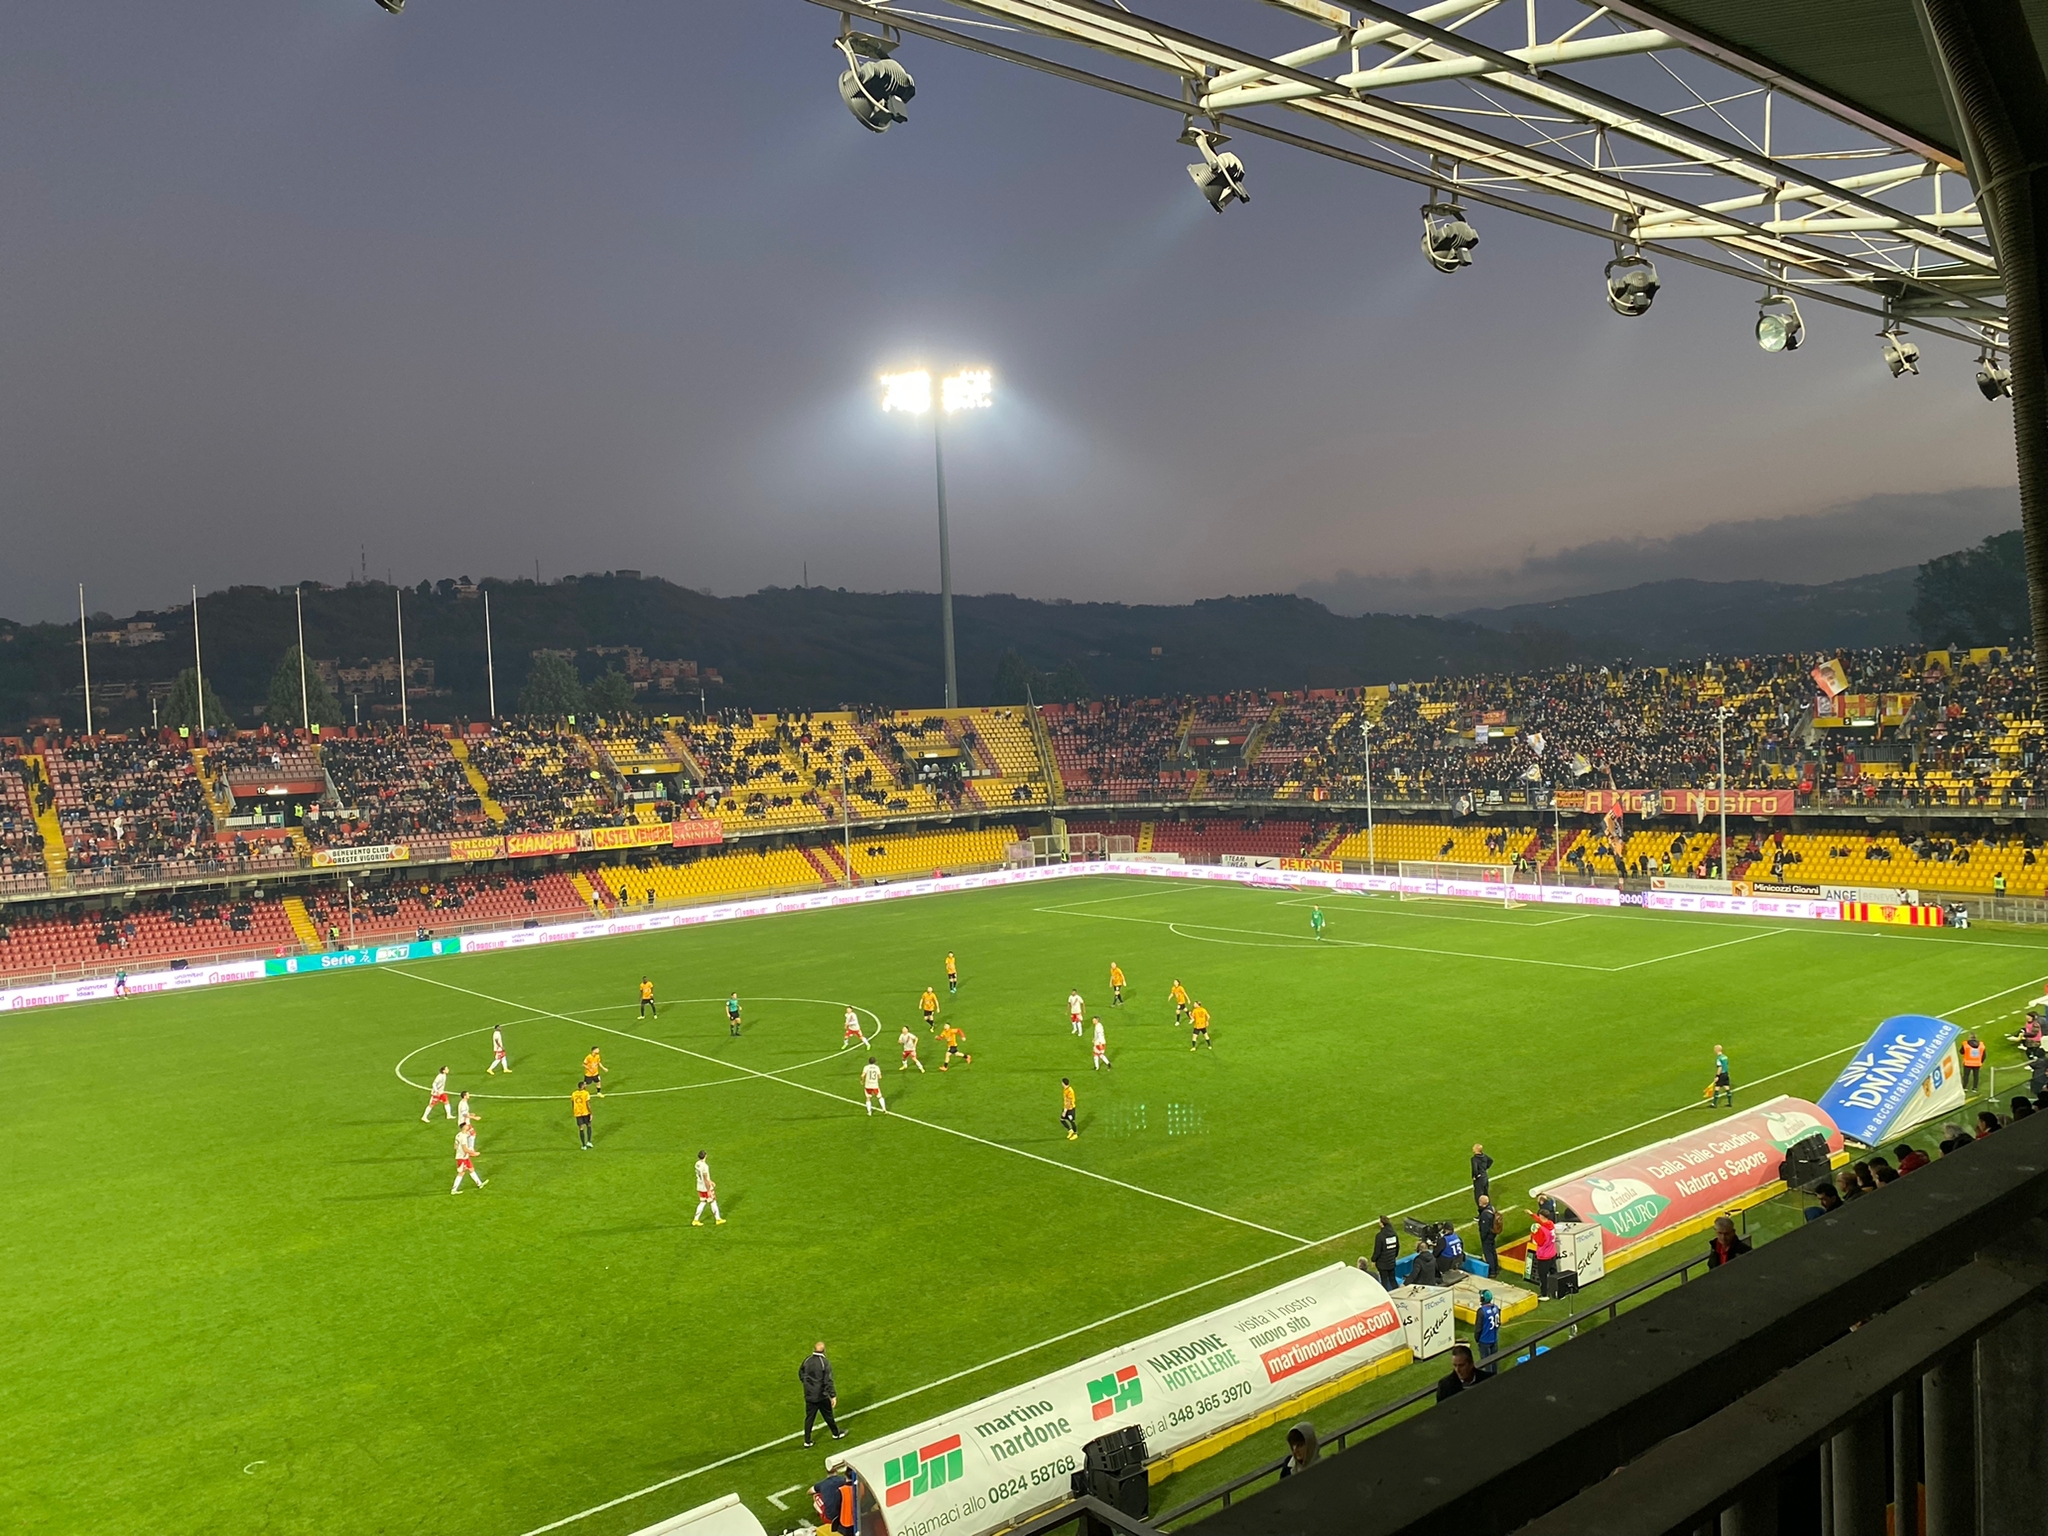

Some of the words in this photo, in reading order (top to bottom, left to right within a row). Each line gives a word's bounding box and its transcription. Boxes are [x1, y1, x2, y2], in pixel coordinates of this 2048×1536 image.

[1586, 792, 1602, 811] A
[1612, 791, 1676, 812] Moo
[1686, 792, 1778, 813] Nostro
[674, 830, 722, 841] SAMNITES
[684, 822, 709, 831] GENS
[332, 848, 371, 857] BENEVENTO
[372, 846, 389, 854] CLUB
[451, 837, 504, 850] STREGONI
[467, 848, 495, 860] NORD
[507, 832, 576, 854] SHANGHAI
[332, 855, 358, 863] ORESTE
[359, 853, 390, 861] VIGORITO
[1279, 857, 1342, 874] PETRONE
[1619, 893, 1643, 905] 90:00
[1754, 883, 1792, 893] Minicozzi
[1792, 885, 1819, 894] Gianni
[321, 954, 356, 968] Serie
[377, 946, 408, 961] BKT
[76, 983, 108, 991] unlimited
[869, 1070, 877, 1081] 13
[1861, 1124, 1878, 1138] we
[1872, 1079, 1912, 1125] accelerate
[1907, 1058, 1927, 1081] your
[1922, 1024, 1953, 1059] advance
[1646, 1160, 1687, 1180] Dalla
[1677, 1148, 1715, 1166] Valle
[1707, 1130, 1761, 1155] Caudina
[1674, 1170, 1720, 1198] Natura
[1717, 1167, 1728, 1180] e
[1724, 1150, 1768, 1176] Sapore
[1610, 1187, 1638, 1209] Avicola
[1608, 1200, 1658, 1237] MAURO
[1451, 1243, 1462, 1256] 15
[1234, 1309, 1269, 1334] visita
[1268, 1309, 1277, 1319] il
[1277, 1294, 1318, 1317] nostro
[1488, 1313, 1500, 1331] 30
[1248, 1325, 1288, 1349] nuovo
[1287, 1315, 1311, 1333] sito
[1423, 1309, 1448, 1347] Sixtus
[1146, 1333, 1228, 1373] NARDONE
[1267, 1309, 1395, 1375] martinonardone.com
[1161, 1348, 1240, 1392] HOTELLERIE
[1158, 1414, 1169, 1433] al
[1168, 1407, 1194, 1428] 348
[1196, 1394, 1220, 1415] 365
[1221, 1380, 1252, 1405] 3970
[974, 1399, 1054, 1438] martino
[989, 1416, 1073, 1462] nardone
[962, 1496, 986, 1517] allo
[988, 1475, 1028, 1504] 0824
[1031, 1454, 1075, 1488] 58768
